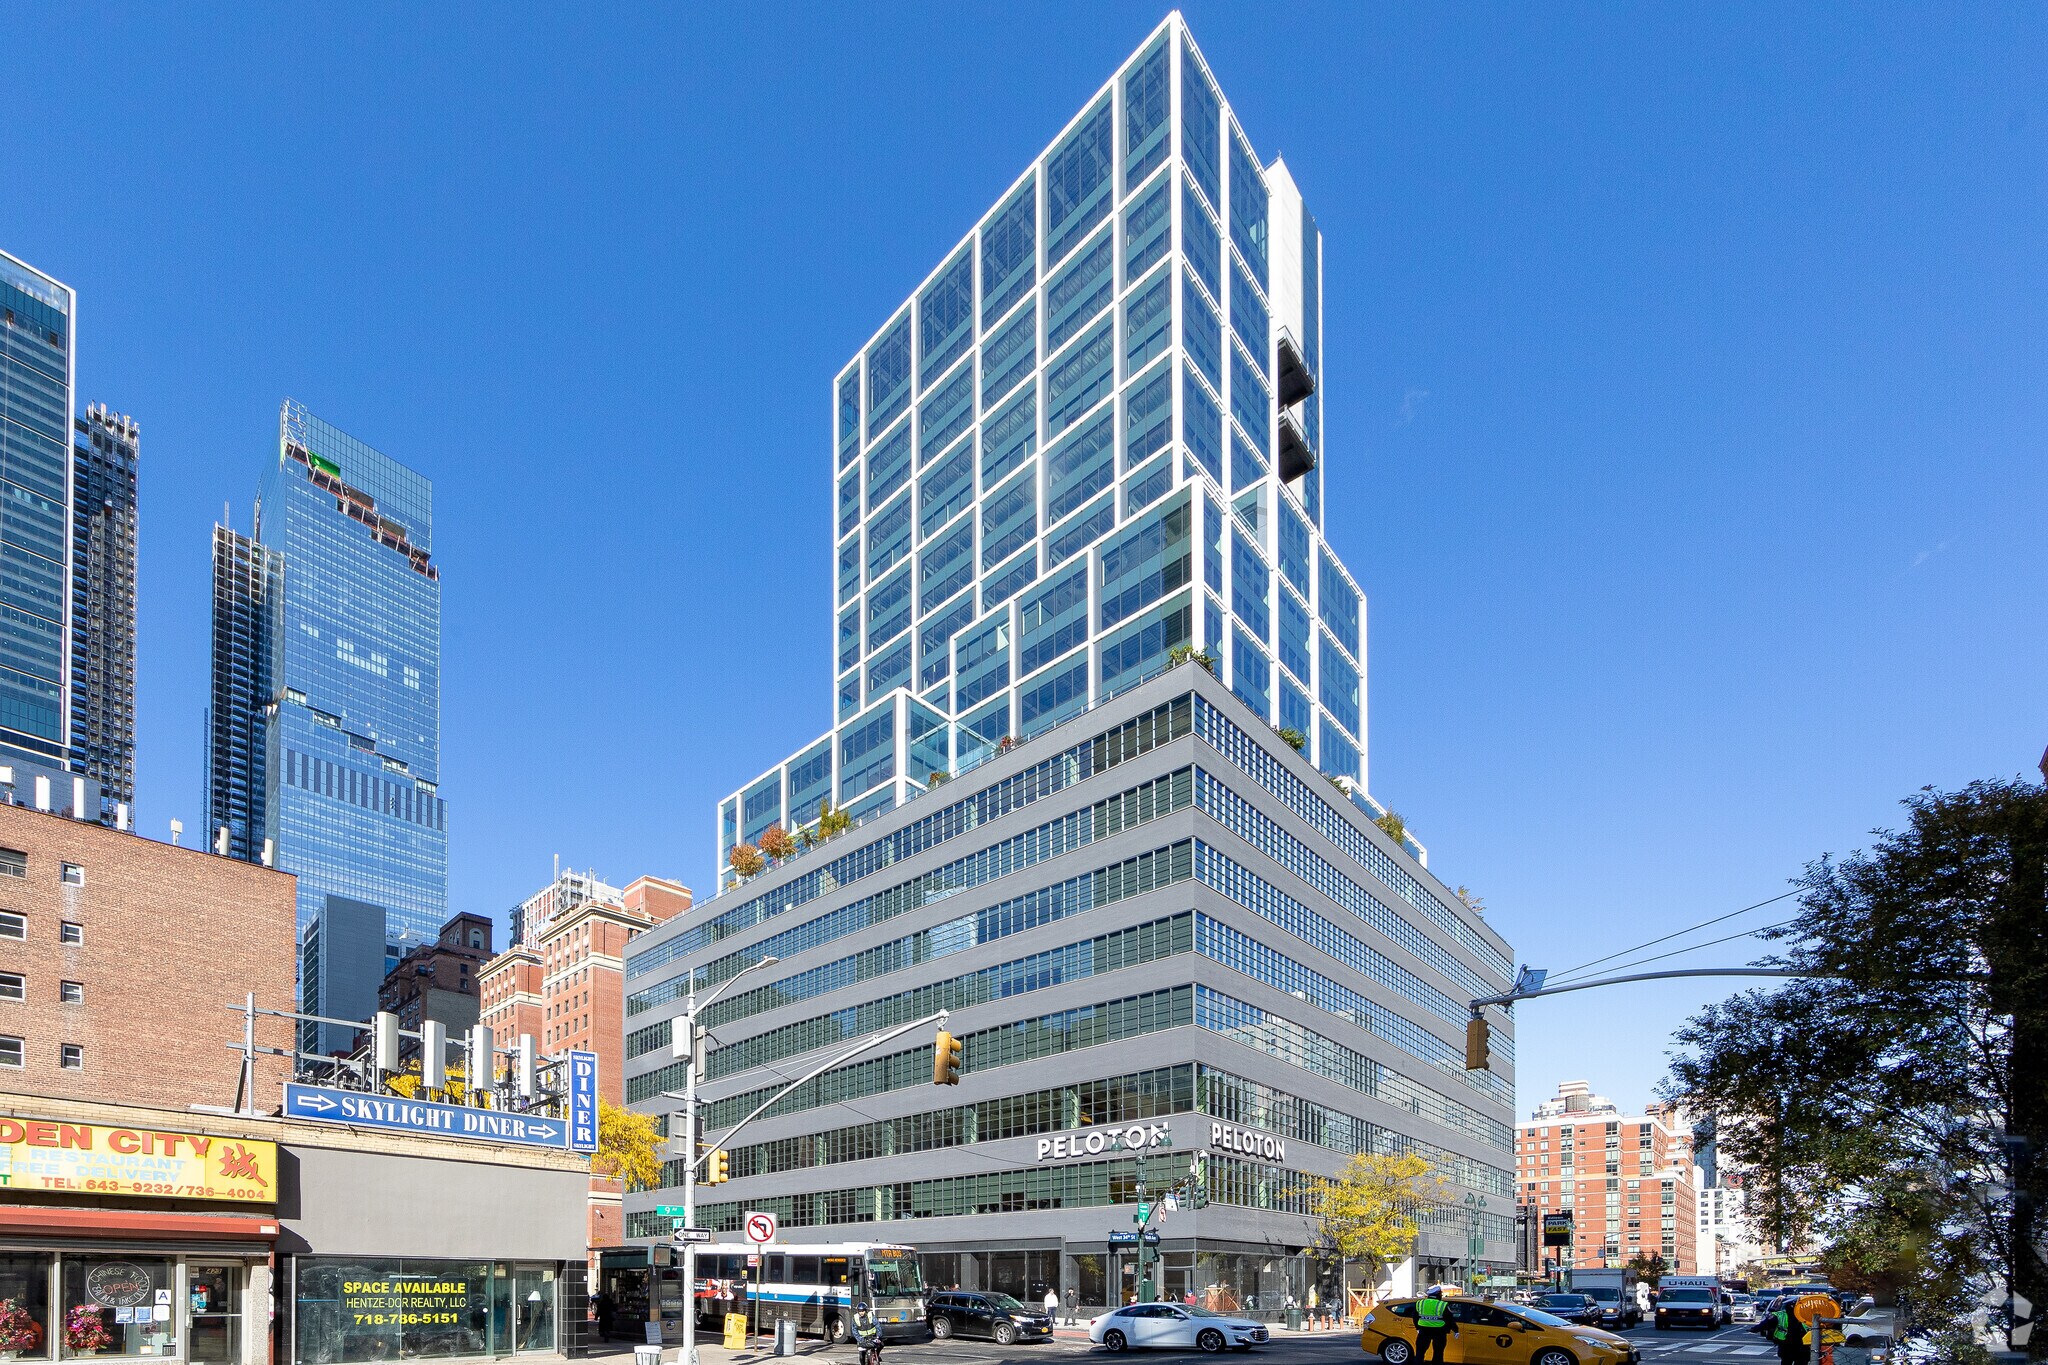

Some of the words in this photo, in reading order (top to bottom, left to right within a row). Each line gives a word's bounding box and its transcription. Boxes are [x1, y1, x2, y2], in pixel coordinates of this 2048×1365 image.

[576, 1061, 592, 1142] DINER
[342, 1096, 454, 1129] SKYLIGHT
[464, 1113, 526, 1138] DINER
[108, 1130, 211, 1157] CITY
[1038, 1121, 1170, 1161] PELOTON
[1212, 1122, 1285, 1162] PELOTON
[31, 1148, 186, 1170] RESTAURANT
[0, 1160, 60, 1175] FREE
[76, 1166, 180, 1183] DELIVERY
[41, 1176, 82, 1189] TEL:
[664, 1206, 671, 1215] 9
[892, 1249, 903, 1258] BUS
[90, 1267, 126, 1283] CHINESE
[102, 1281, 140, 1295] OPEN
[343, 1281, 389, 1294] SPACE
[393, 1281, 466, 1294] AVAILABLE
[159, 1291, 168, 1300] A
[346, 1297, 409, 1308] HENTZE-DOR
[411, 1297, 448, 1309] REALTY,
[449, 1297, 467, 1308] LLC
[353, 1312, 458, 1325] 718-786-5151
[1499, 1336, 1510, 1346] T
